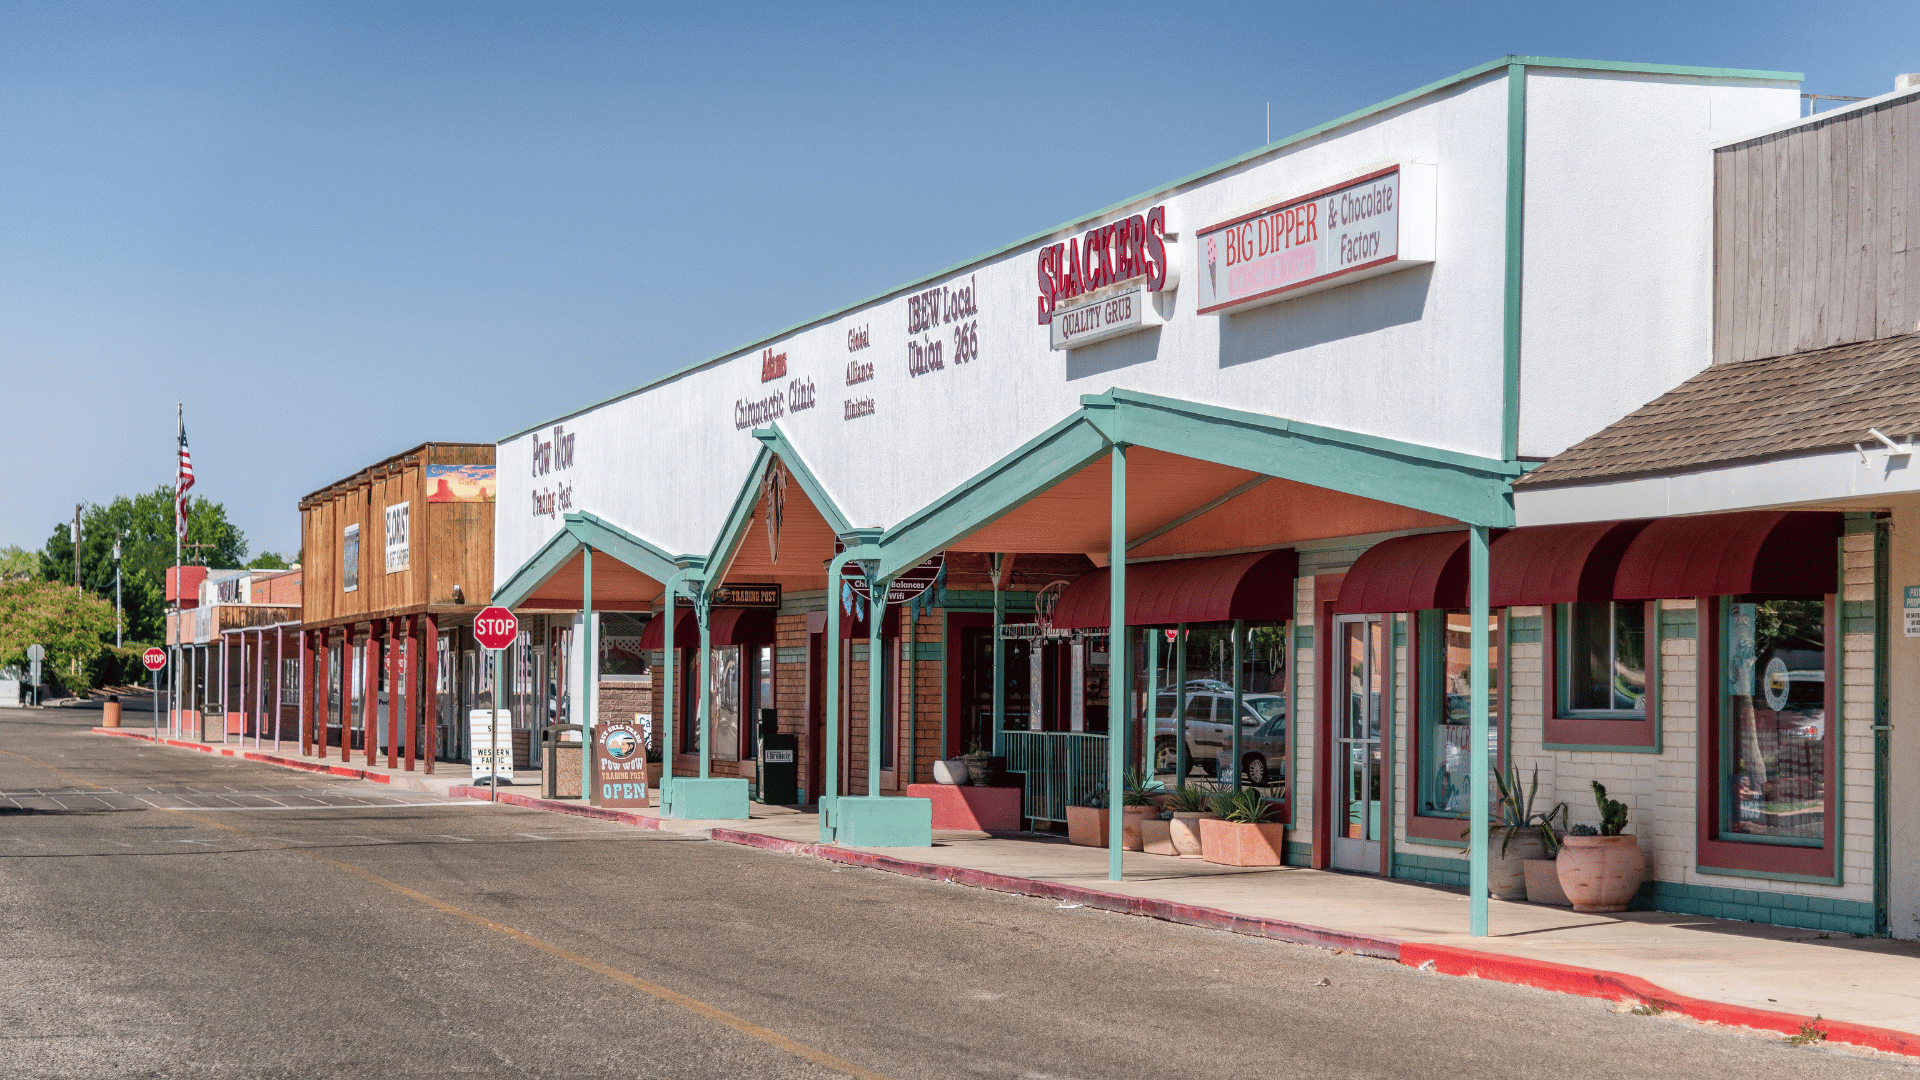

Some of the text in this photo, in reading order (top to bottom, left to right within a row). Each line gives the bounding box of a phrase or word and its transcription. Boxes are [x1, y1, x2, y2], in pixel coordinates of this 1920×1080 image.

[1328, 184, 1393, 230] & Chocolate
[1225, 202, 1318, 267] BIG DIPPER
[1341, 230, 1380, 265] Factory
[1038, 206, 1167, 325] SLACKERS
[1232, 271, 1244, 291] Ice
[1246, 266, 1272, 287] Cream
[1274, 258, 1282, 279] &
[908, 273, 978, 335] IBEW Local
[1062, 296, 1132, 340] QUALITY GRUB
[847, 323, 870, 353] Global
[908, 319, 978, 378] Union 266
[761, 347, 787, 384] Adams
[846, 359, 874, 387] Alliance
[735, 374, 816, 431] Chiropractic Clinic
[844, 394, 875, 421] Ministries
[532, 424, 575, 478] Pow Wow
[532, 479, 573, 520] Trading Post
[386, 506, 409, 548] FLORIST
[731, 590, 776, 602] TRADING POST
[889, 592, 905, 600] Wifi
[891, 580, 925, 589] Balances
[477, 619, 515, 636] STOP
[144, 654, 165, 664] STOP
[599, 729, 609, 744] BUY
[607, 724, 625, 733] SELL
[625, 725, 643, 744] TRADE
[601, 757, 644, 770] POW WOW
[601, 771, 645, 780] TRADING POST
[603, 783, 645, 799] OPEN
